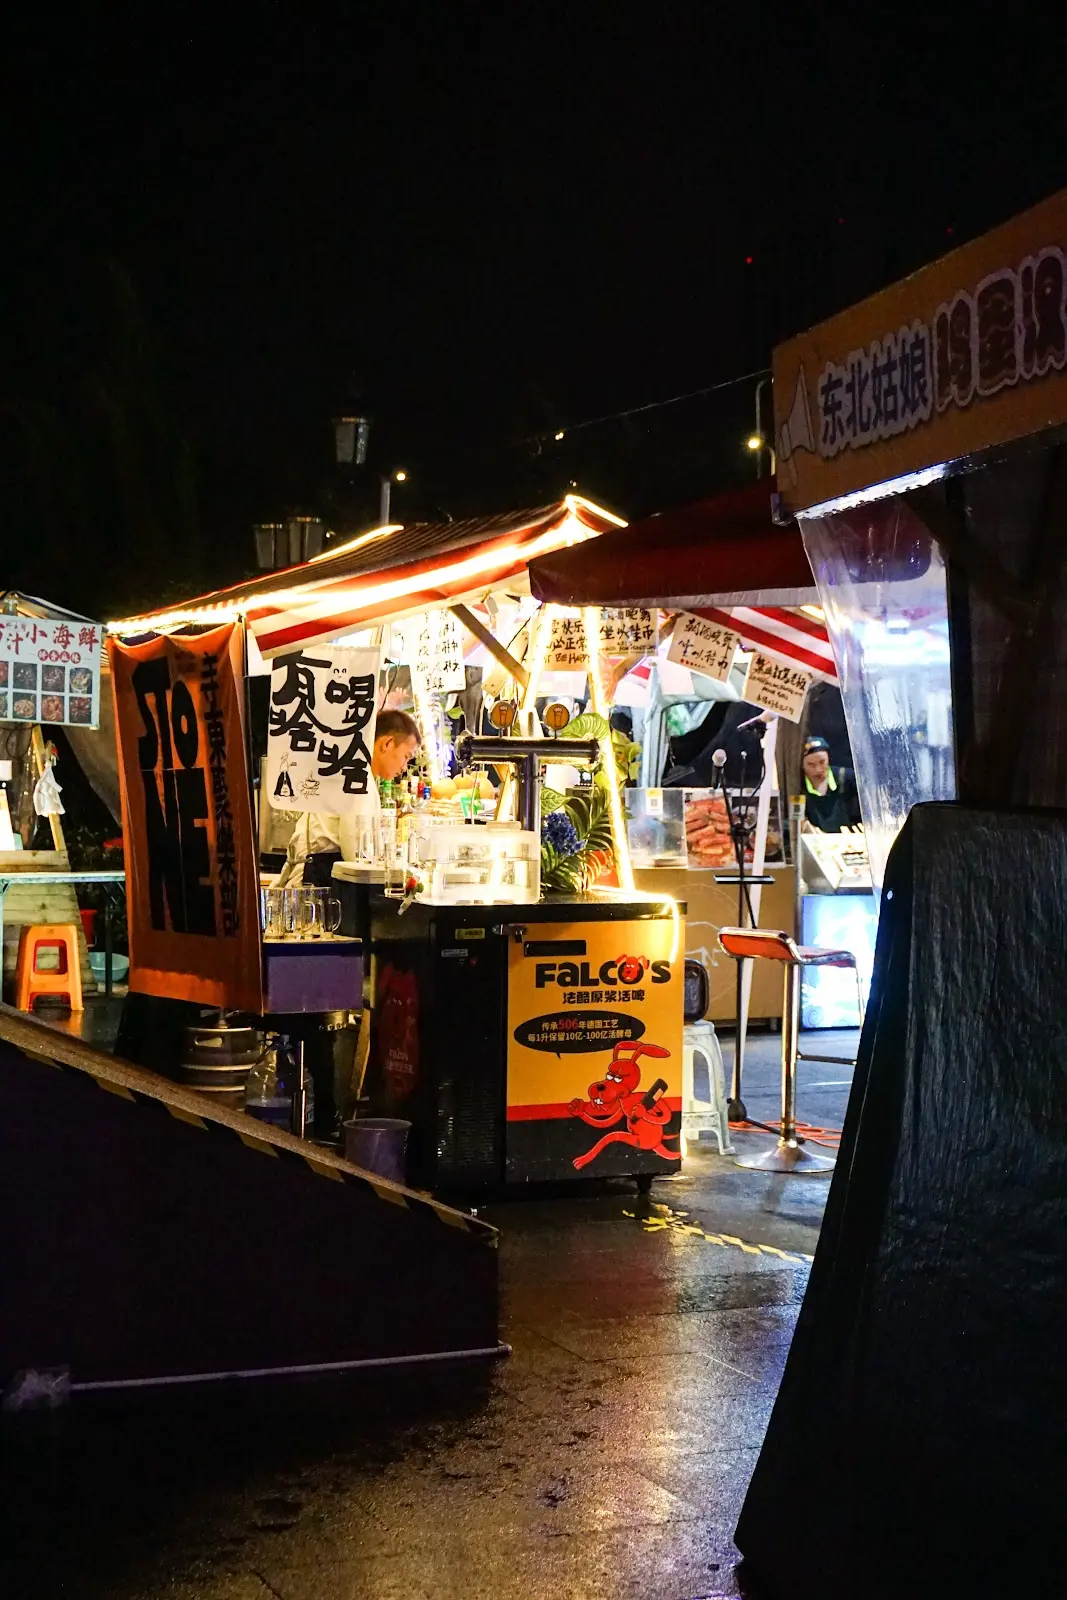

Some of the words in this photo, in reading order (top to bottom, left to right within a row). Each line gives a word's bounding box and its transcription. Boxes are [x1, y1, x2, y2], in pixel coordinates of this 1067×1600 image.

[821, 334, 929, 446] 东北姑娘
[0, 622, 99, 655] 汁小海鲜
[538, 617, 584, 635] 要快乐
[562, 989, 645, 1004] 法酷原浆活啤
